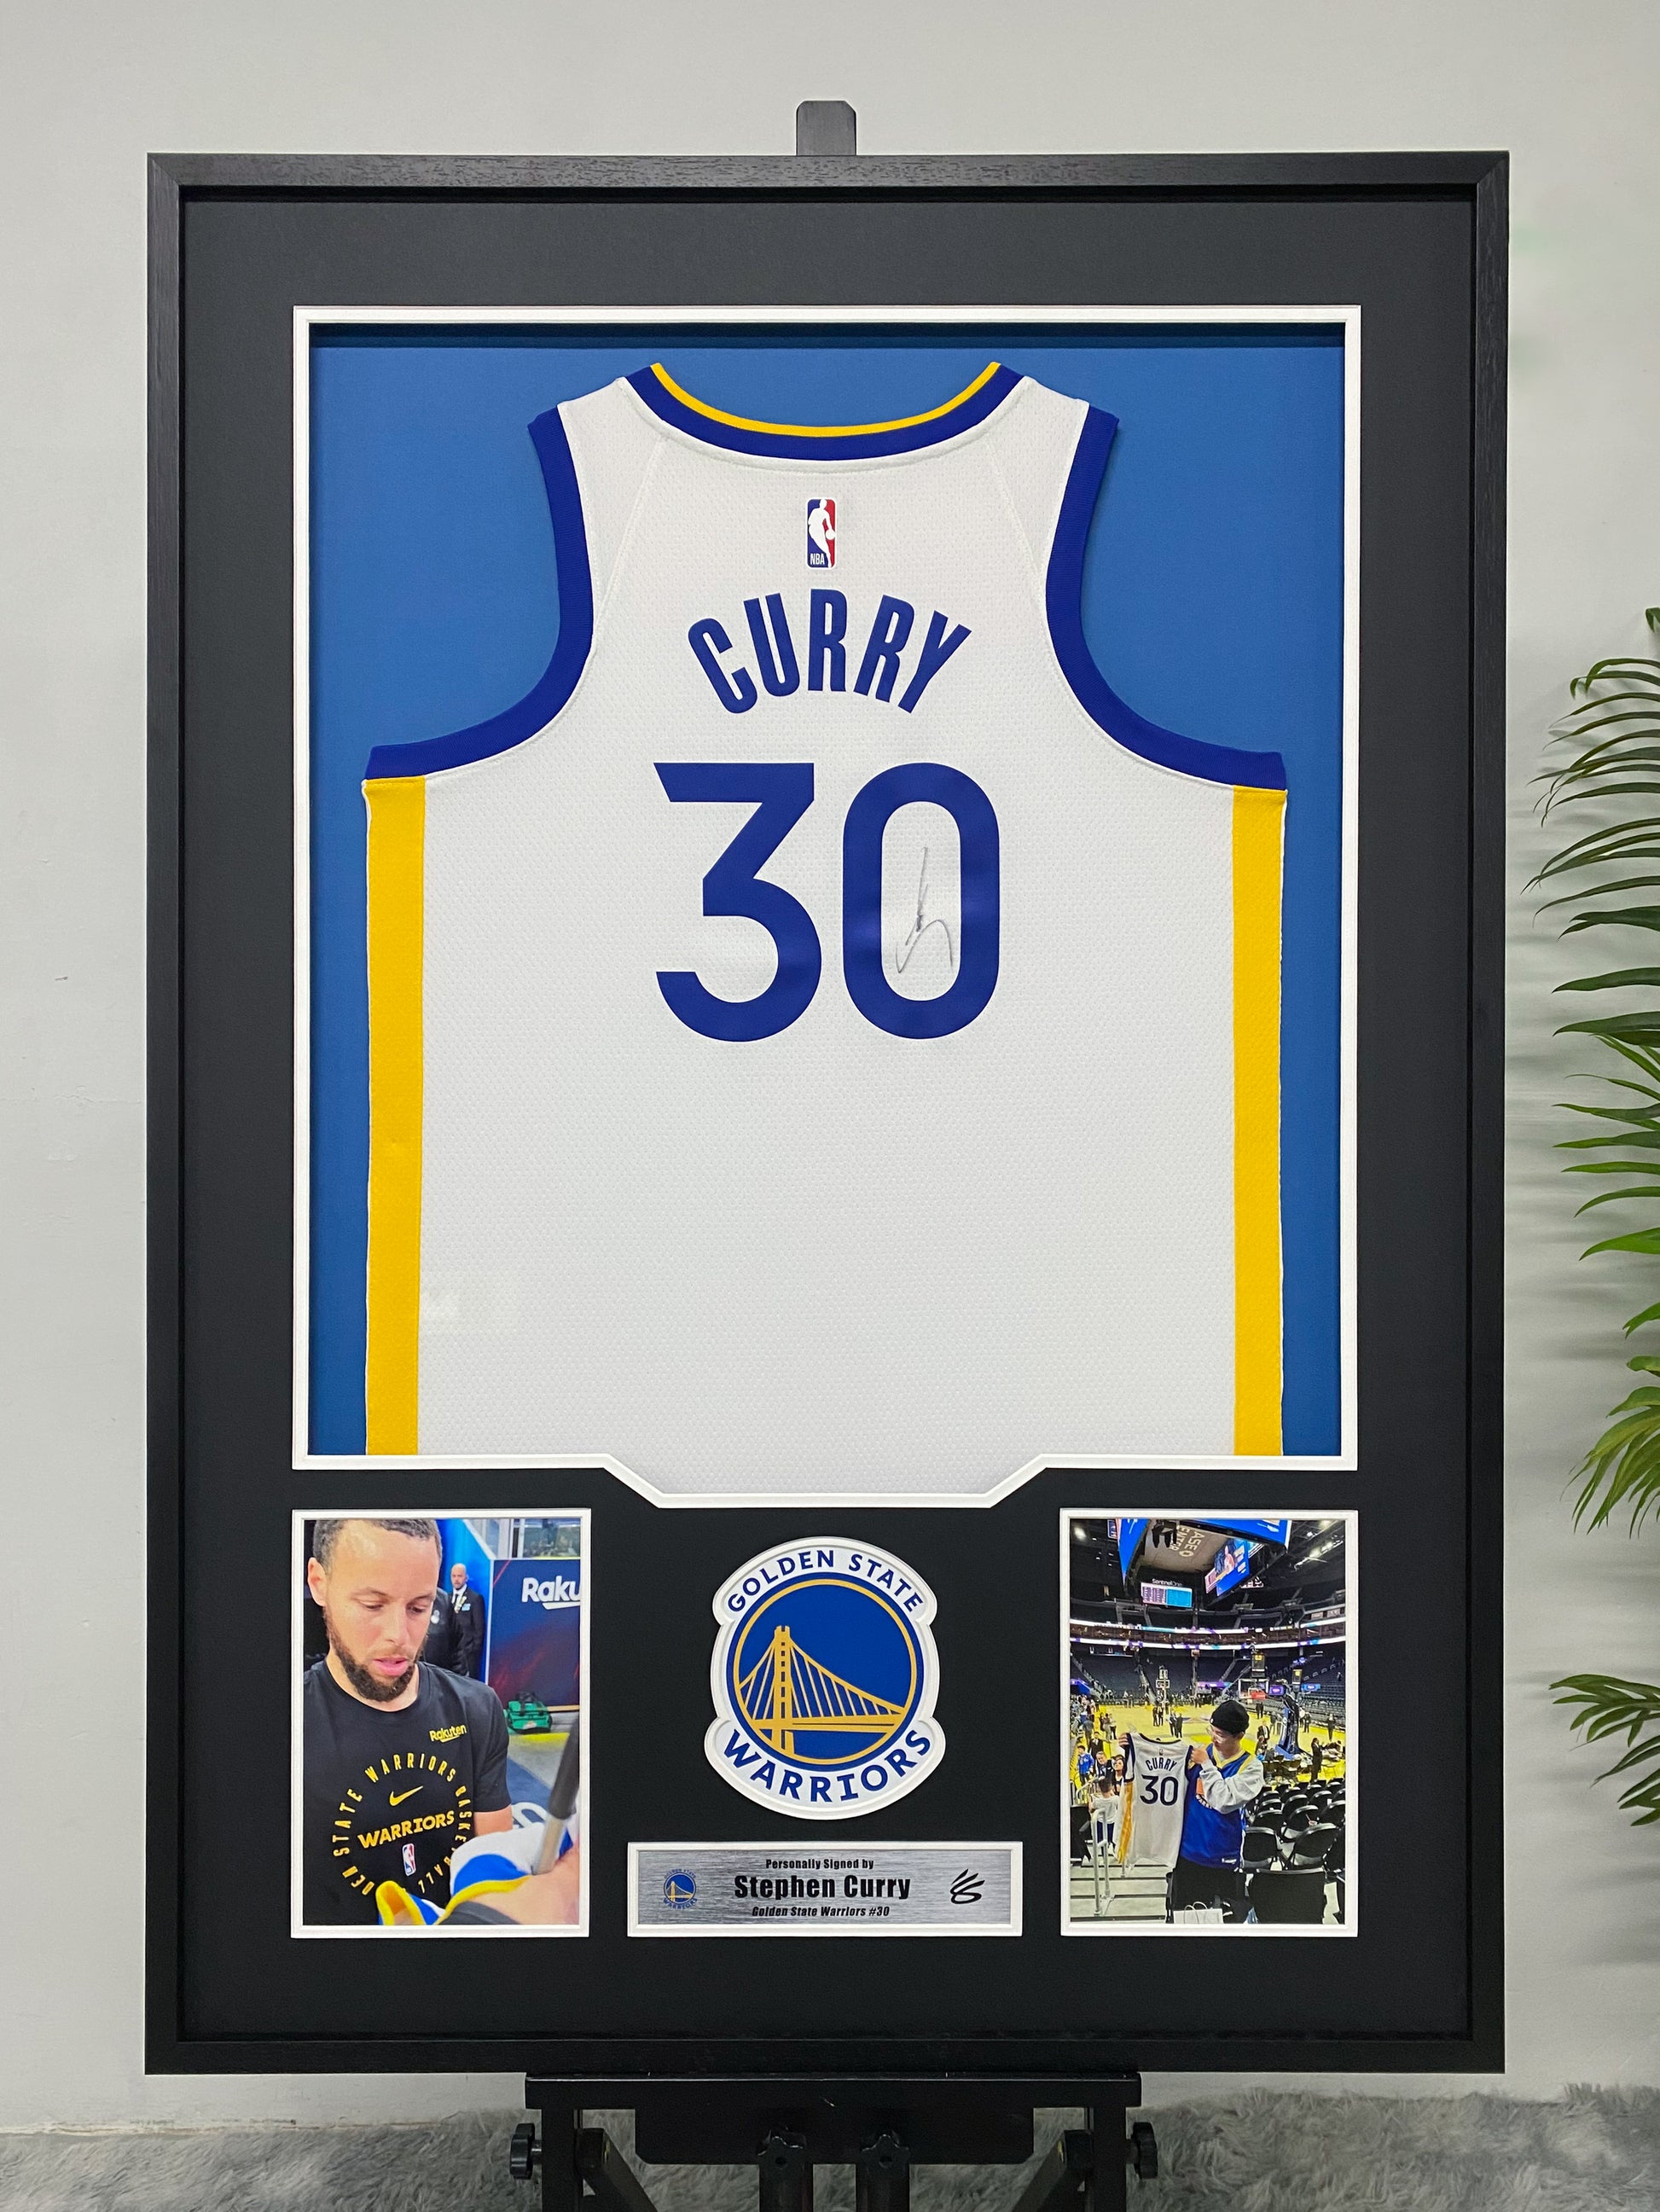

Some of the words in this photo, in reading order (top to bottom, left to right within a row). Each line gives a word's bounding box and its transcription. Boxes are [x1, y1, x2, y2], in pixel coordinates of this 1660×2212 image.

[810, 553, 825, 565] NBA
[688, 589, 972, 714] CURRY
[653, 762, 1000, 1042] 30
[728, 1550, 834, 1611] GOLDEN
[849, 1553, 924, 1612] STATE
[429, 1724, 467, 1743] Rakuten
[364, 1752, 456, 1783] WARRIORS
[723, 1728, 932, 1803] WARRIORS
[1145, 1757, 1177, 1772] CURRY
[1140, 1774, 1179, 1806] 30
[332, 1788, 363, 1856] STATE
[357, 1810, 455, 1849] WARRIORS
[418, 1785, 473, 1894] BASKEBALL
[766, 1859, 821, 1870] Personally
[823, 1859, 859, 1870] Signed
[862, 1859, 874, 1870] by
[342, 1866, 375, 1896] DEN
[734, 1875, 835, 1900] Stephen
[844, 1875, 910, 1900] Curry
[752, 1907, 790, 1916] Golden
[790, 1907, 817, 1916] State
[821, 1907, 866, 1916] Warriors
[868, 1907, 890, 1916] #30
